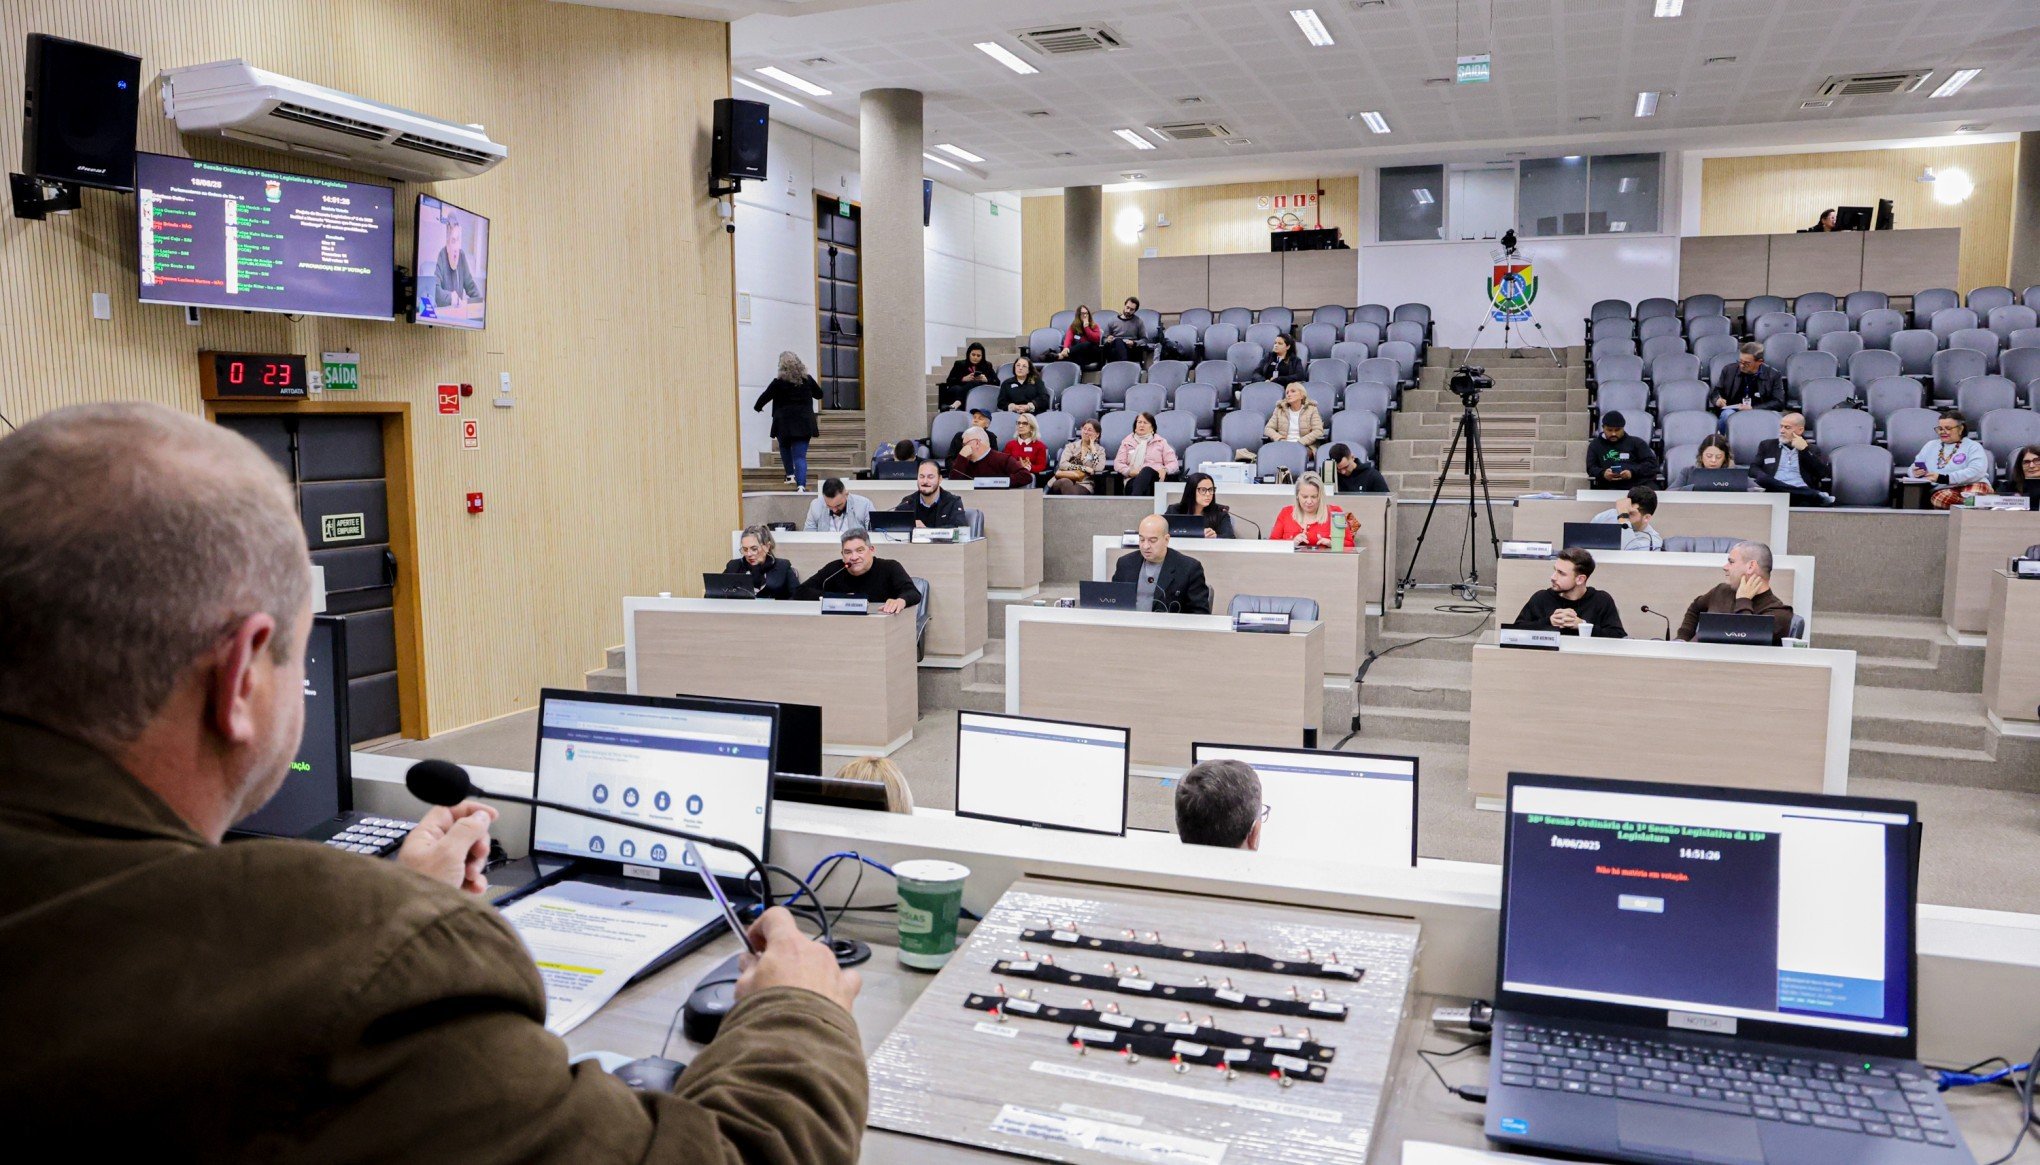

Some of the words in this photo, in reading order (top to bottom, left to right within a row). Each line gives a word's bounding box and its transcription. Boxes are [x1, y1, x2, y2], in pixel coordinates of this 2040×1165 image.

[1458, 63, 1488, 79] SAÍDA
[230, 362, 245, 384] 0
[263, 364, 292, 385] 23
[325, 364, 357, 385] SAÍDA
[337, 518, 355, 527] APERTE
[355, 518, 360, 526] E
[337, 526, 360, 535] EMPURRE
[305, 688, 317, 696] Novo
[289, 761, 311, 772] TAÇÃO
[1544, 815, 1576, 827] Sessão
[1577, 818, 1621, 831] Ordinária
[1622, 821, 1635, 832] da
[1648, 824, 1680, 835] Sessão
[1681, 826, 1733, 840] Legislativa
[1734, 830, 1747, 840] da
[1617, 830, 1671, 844] Legislatura
[1595, 865, 1611, 875] Não
[1621, 867, 1648, 878] matéria
[1649, 871, 1660, 879] em
